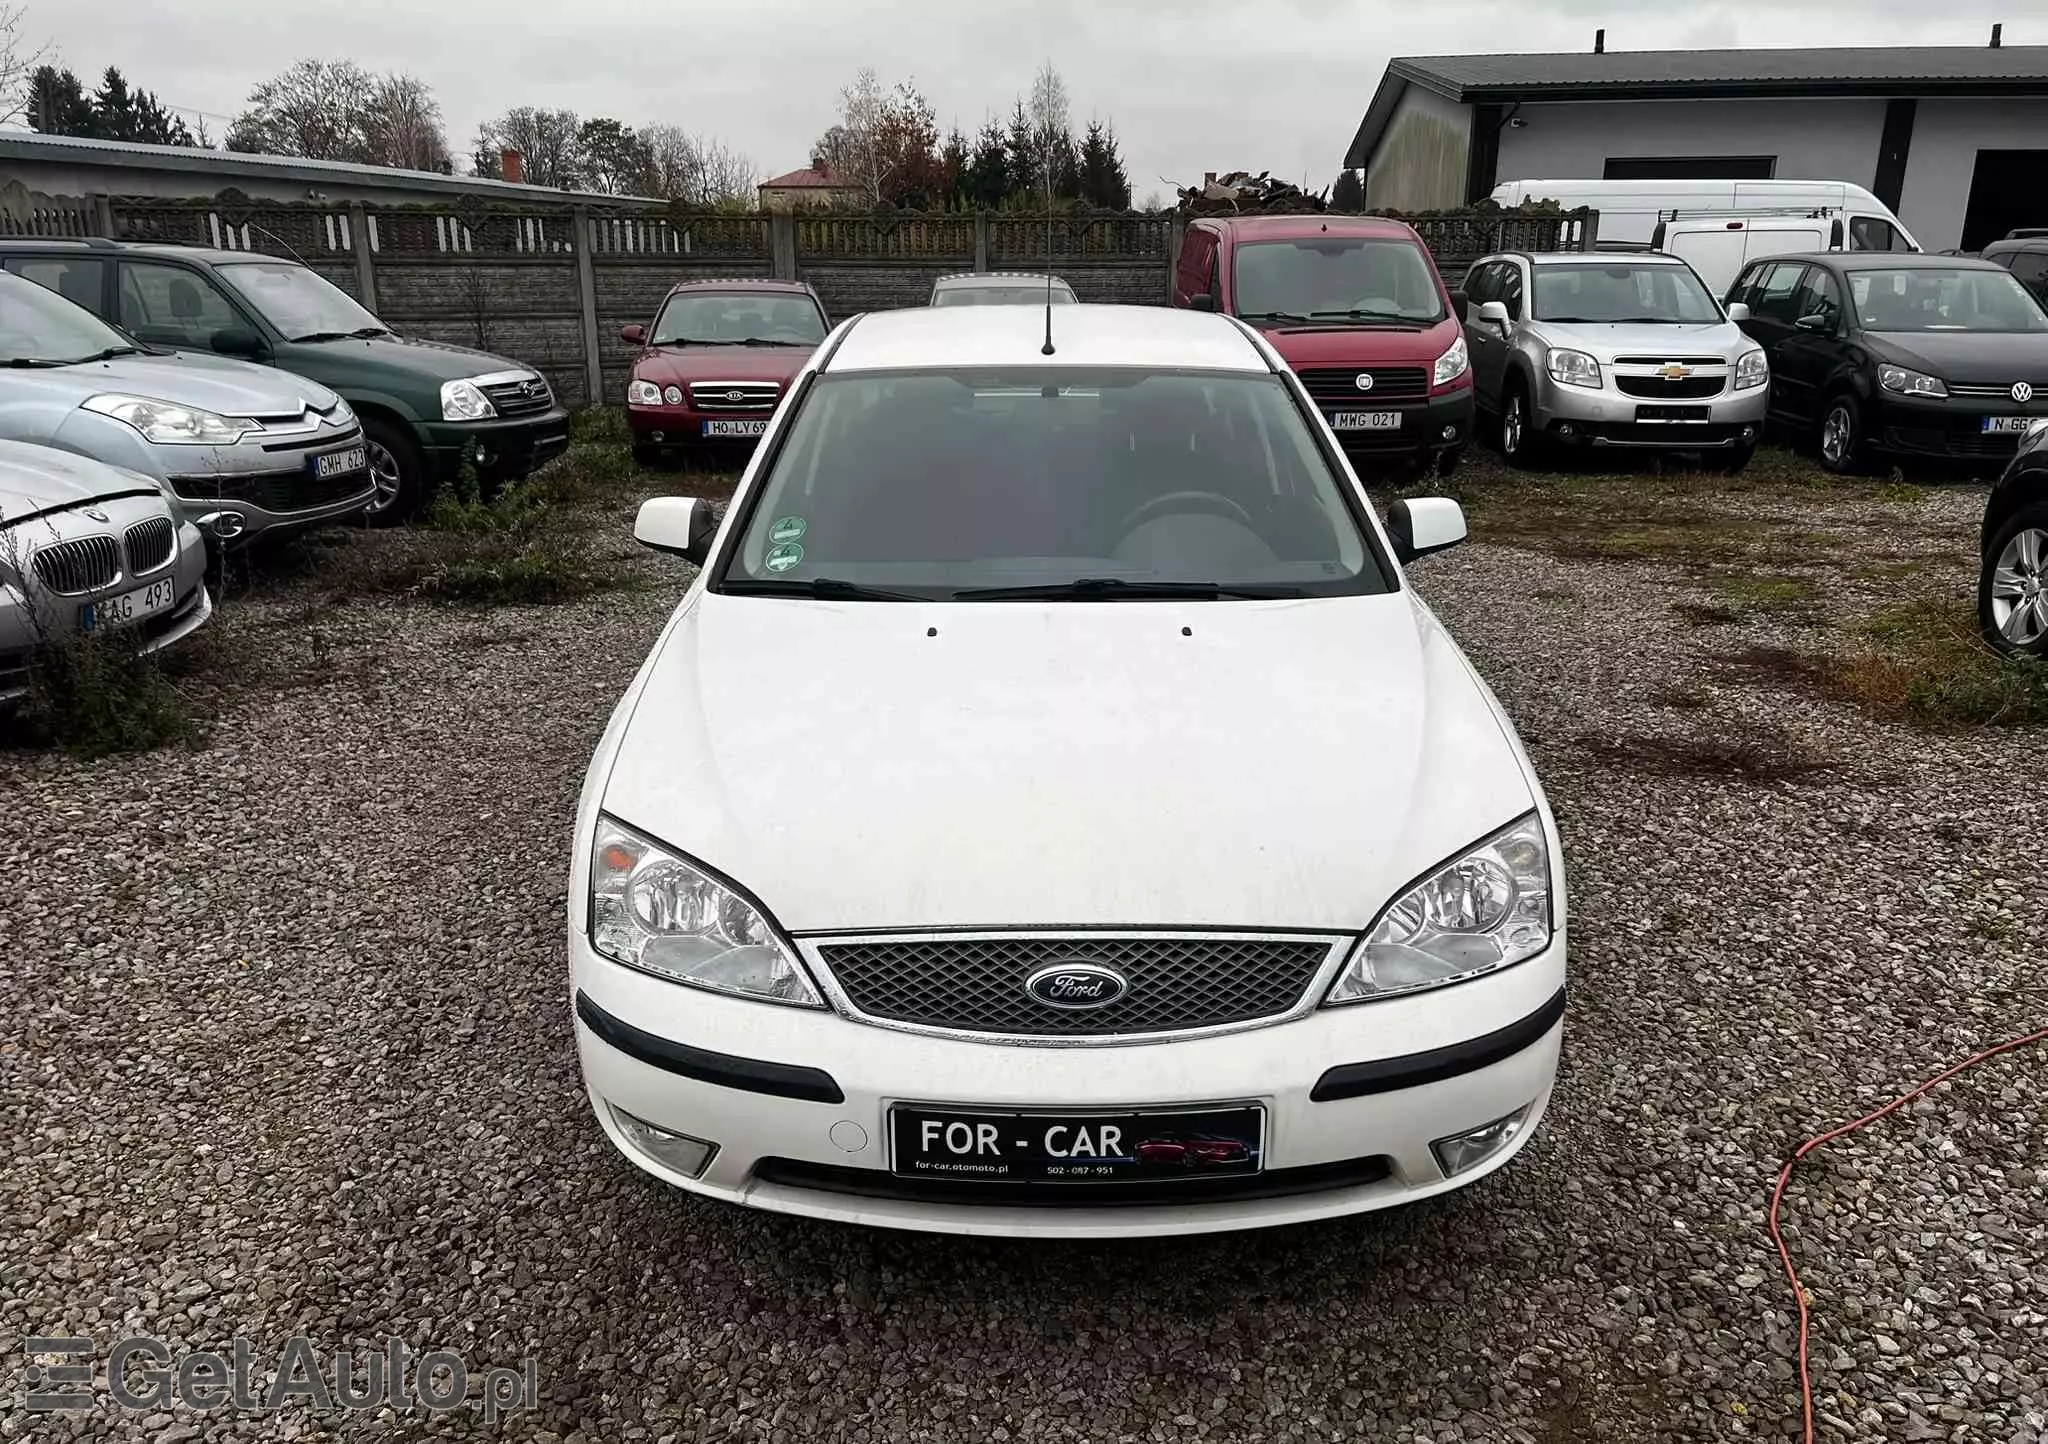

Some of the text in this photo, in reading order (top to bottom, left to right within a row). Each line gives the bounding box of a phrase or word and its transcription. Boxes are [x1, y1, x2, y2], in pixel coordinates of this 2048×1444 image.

[712, 422, 728, 434] HO
[735, 422, 750, 434] LY
[1340, 413, 1396, 427] MWG 021
[1995, 418, 2005, 430] N
[320, 449, 365, 475] GMH 623
[145, 580, 171, 609] 493
[1050, 975, 1104, 998] Ford
[921, 1120, 1001, 1156] FOR
[1044, 1125, 1124, 1158] CAR
[915, 1160, 1009, 1174] for-car.otomoto.pl
